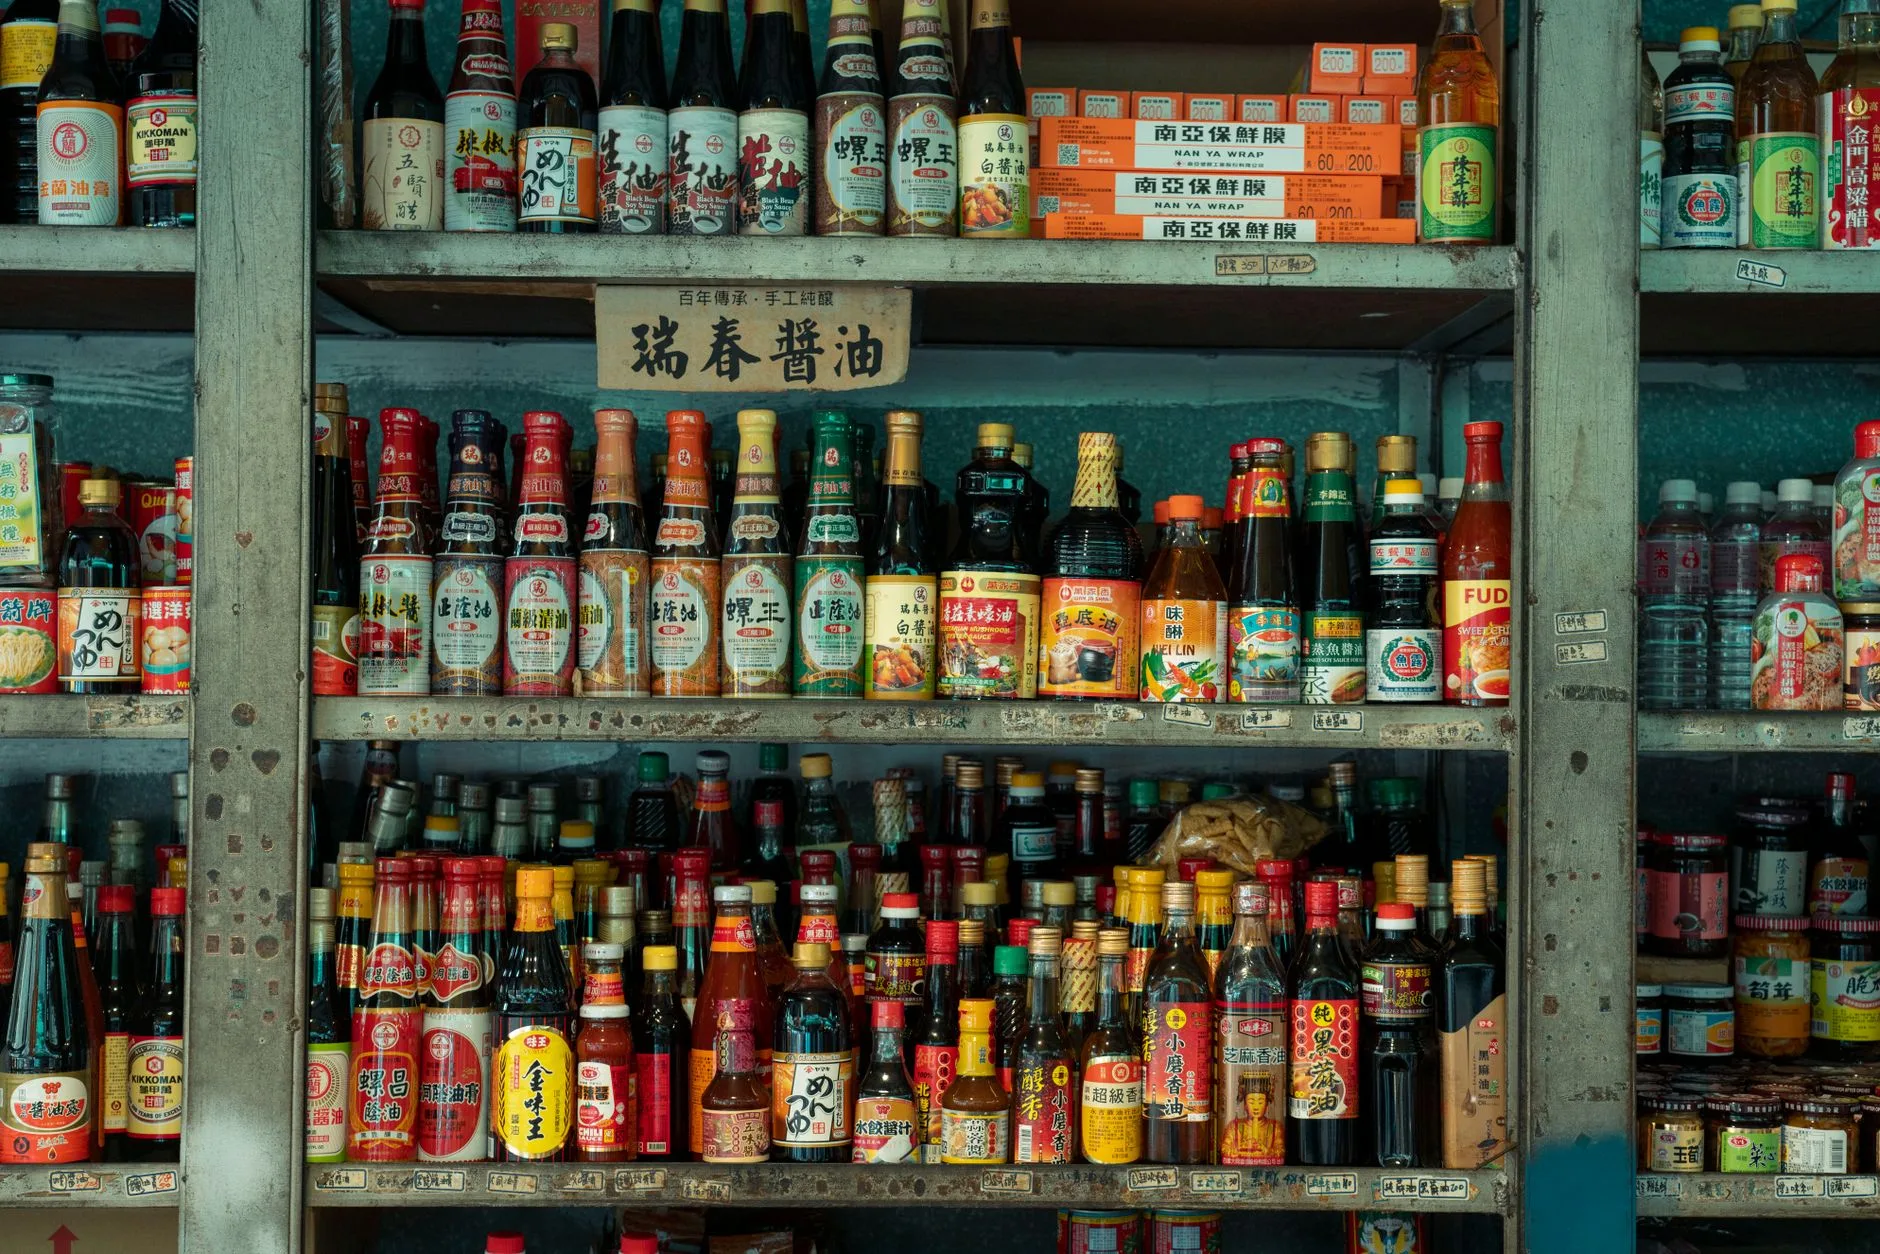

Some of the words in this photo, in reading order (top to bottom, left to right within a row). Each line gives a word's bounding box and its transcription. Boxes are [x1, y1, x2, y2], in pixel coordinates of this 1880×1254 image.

[1322, 57, 1344, 71] 200
[1374, 57, 1396, 72] 200
[1034, 101, 1056, 115] 200
[1088, 103, 1109, 117] 200
[1141, 104, 1162, 119] 200
[1193, 106, 1213, 120] 200
[1244, 107, 1266, 121] 200
[1300, 108, 1321, 122] 200
[1351, 108, 1373, 122] 200
[136, 128, 188, 139] KIKKOMAN
[1154, 125, 1286, 145] 南亞保鮮膜
[834, 135, 887, 166] 螺王
[897, 137, 956, 168] 螺王
[1175, 150, 1200, 158] NAN
[1207, 150, 1221, 158] YA
[1227, 151, 1264, 159] WRAP
[600, 128, 659, 195] 生抽
[670, 129, 729, 196] 生抽
[981, 157, 1026, 176] 白醬油
[521, 147, 567, 211] めんつゆ
[1134, 176, 1266, 196] 南亞保鮮膜
[774, 204, 793, 212] Sauce
[1155, 202, 1180, 210] NAN
[1186, 202, 1202, 210] YA
[1208, 202, 1245, 211] WRAP
[1693, 197, 1721, 213] 魚露
[1162, 221, 1297, 240] 南亞保鮮膜
[630, 314, 885, 385] 瑞春醬油
[176, 471, 191, 489] 選
[1464, 588, 1508, 604] FUD
[438, 595, 492, 620] 正蔭油
[726, 597, 786, 628] 螺王
[809, 599, 862, 622] 正蔭油
[510, 607, 567, 630] 蘭級清油
[1457, 626, 1488, 636] SWEET
[71, 609, 124, 673] めんつゆ
[1152, 644, 1174, 655] WEI
[1176, 644, 1195, 655] LIN
[1311, 642, 1363, 657] 蒸魚醬油
[1395, 653, 1427, 667] 魚露
[1819, 877, 1870, 892] 水餃醬汁
[806, 928, 834, 938] 無添加
[526, 1035, 548, 1048] 味王
[1223, 1047, 1286, 1065] 芝麻香油
[1164, 1031, 1186, 1117] 小磨香油
[1478, 1050, 1490, 1090] 黑麻油
[131, 1075, 183, 1085] KIKKOMAN
[522, 1059, 553, 1142] 金味王
[1020, 1067, 1045, 1122] 醇香
[1092, 1086, 1138, 1105] 超級香
[28, 1098, 82, 1121] 醬油露
[363, 1102, 402, 1122] 蔭油
[784, 1074, 836, 1136] めんつゆ
[855, 1120, 912, 1136] 水餃醬汁
